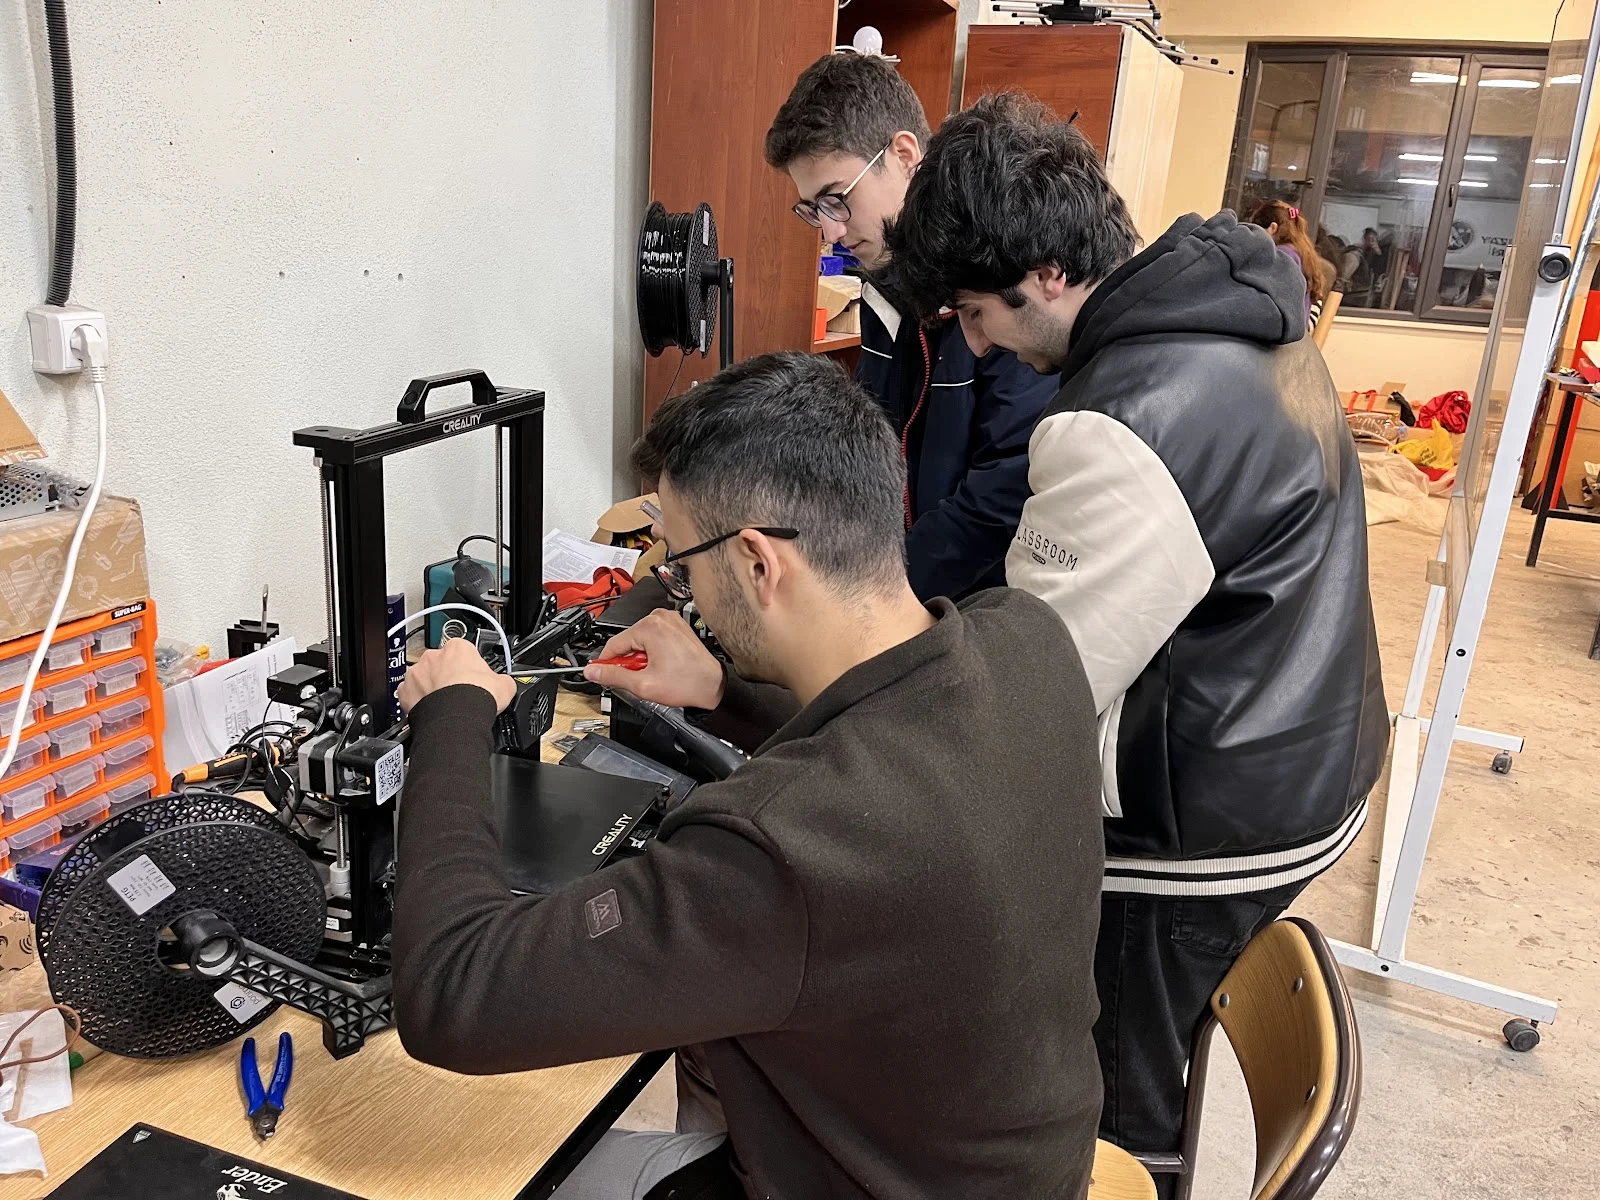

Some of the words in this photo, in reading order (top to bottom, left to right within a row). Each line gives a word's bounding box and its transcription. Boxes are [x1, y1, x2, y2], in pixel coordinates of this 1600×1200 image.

[442, 412, 482, 433] CREALITY
[114, 603, 143, 618] SUPER-BAG
[388, 650, 406, 669] aft
[591, 813, 633, 855] CREALITY
[120, 886, 137, 902] PETG
[221, 1165, 288, 1194] Ender
